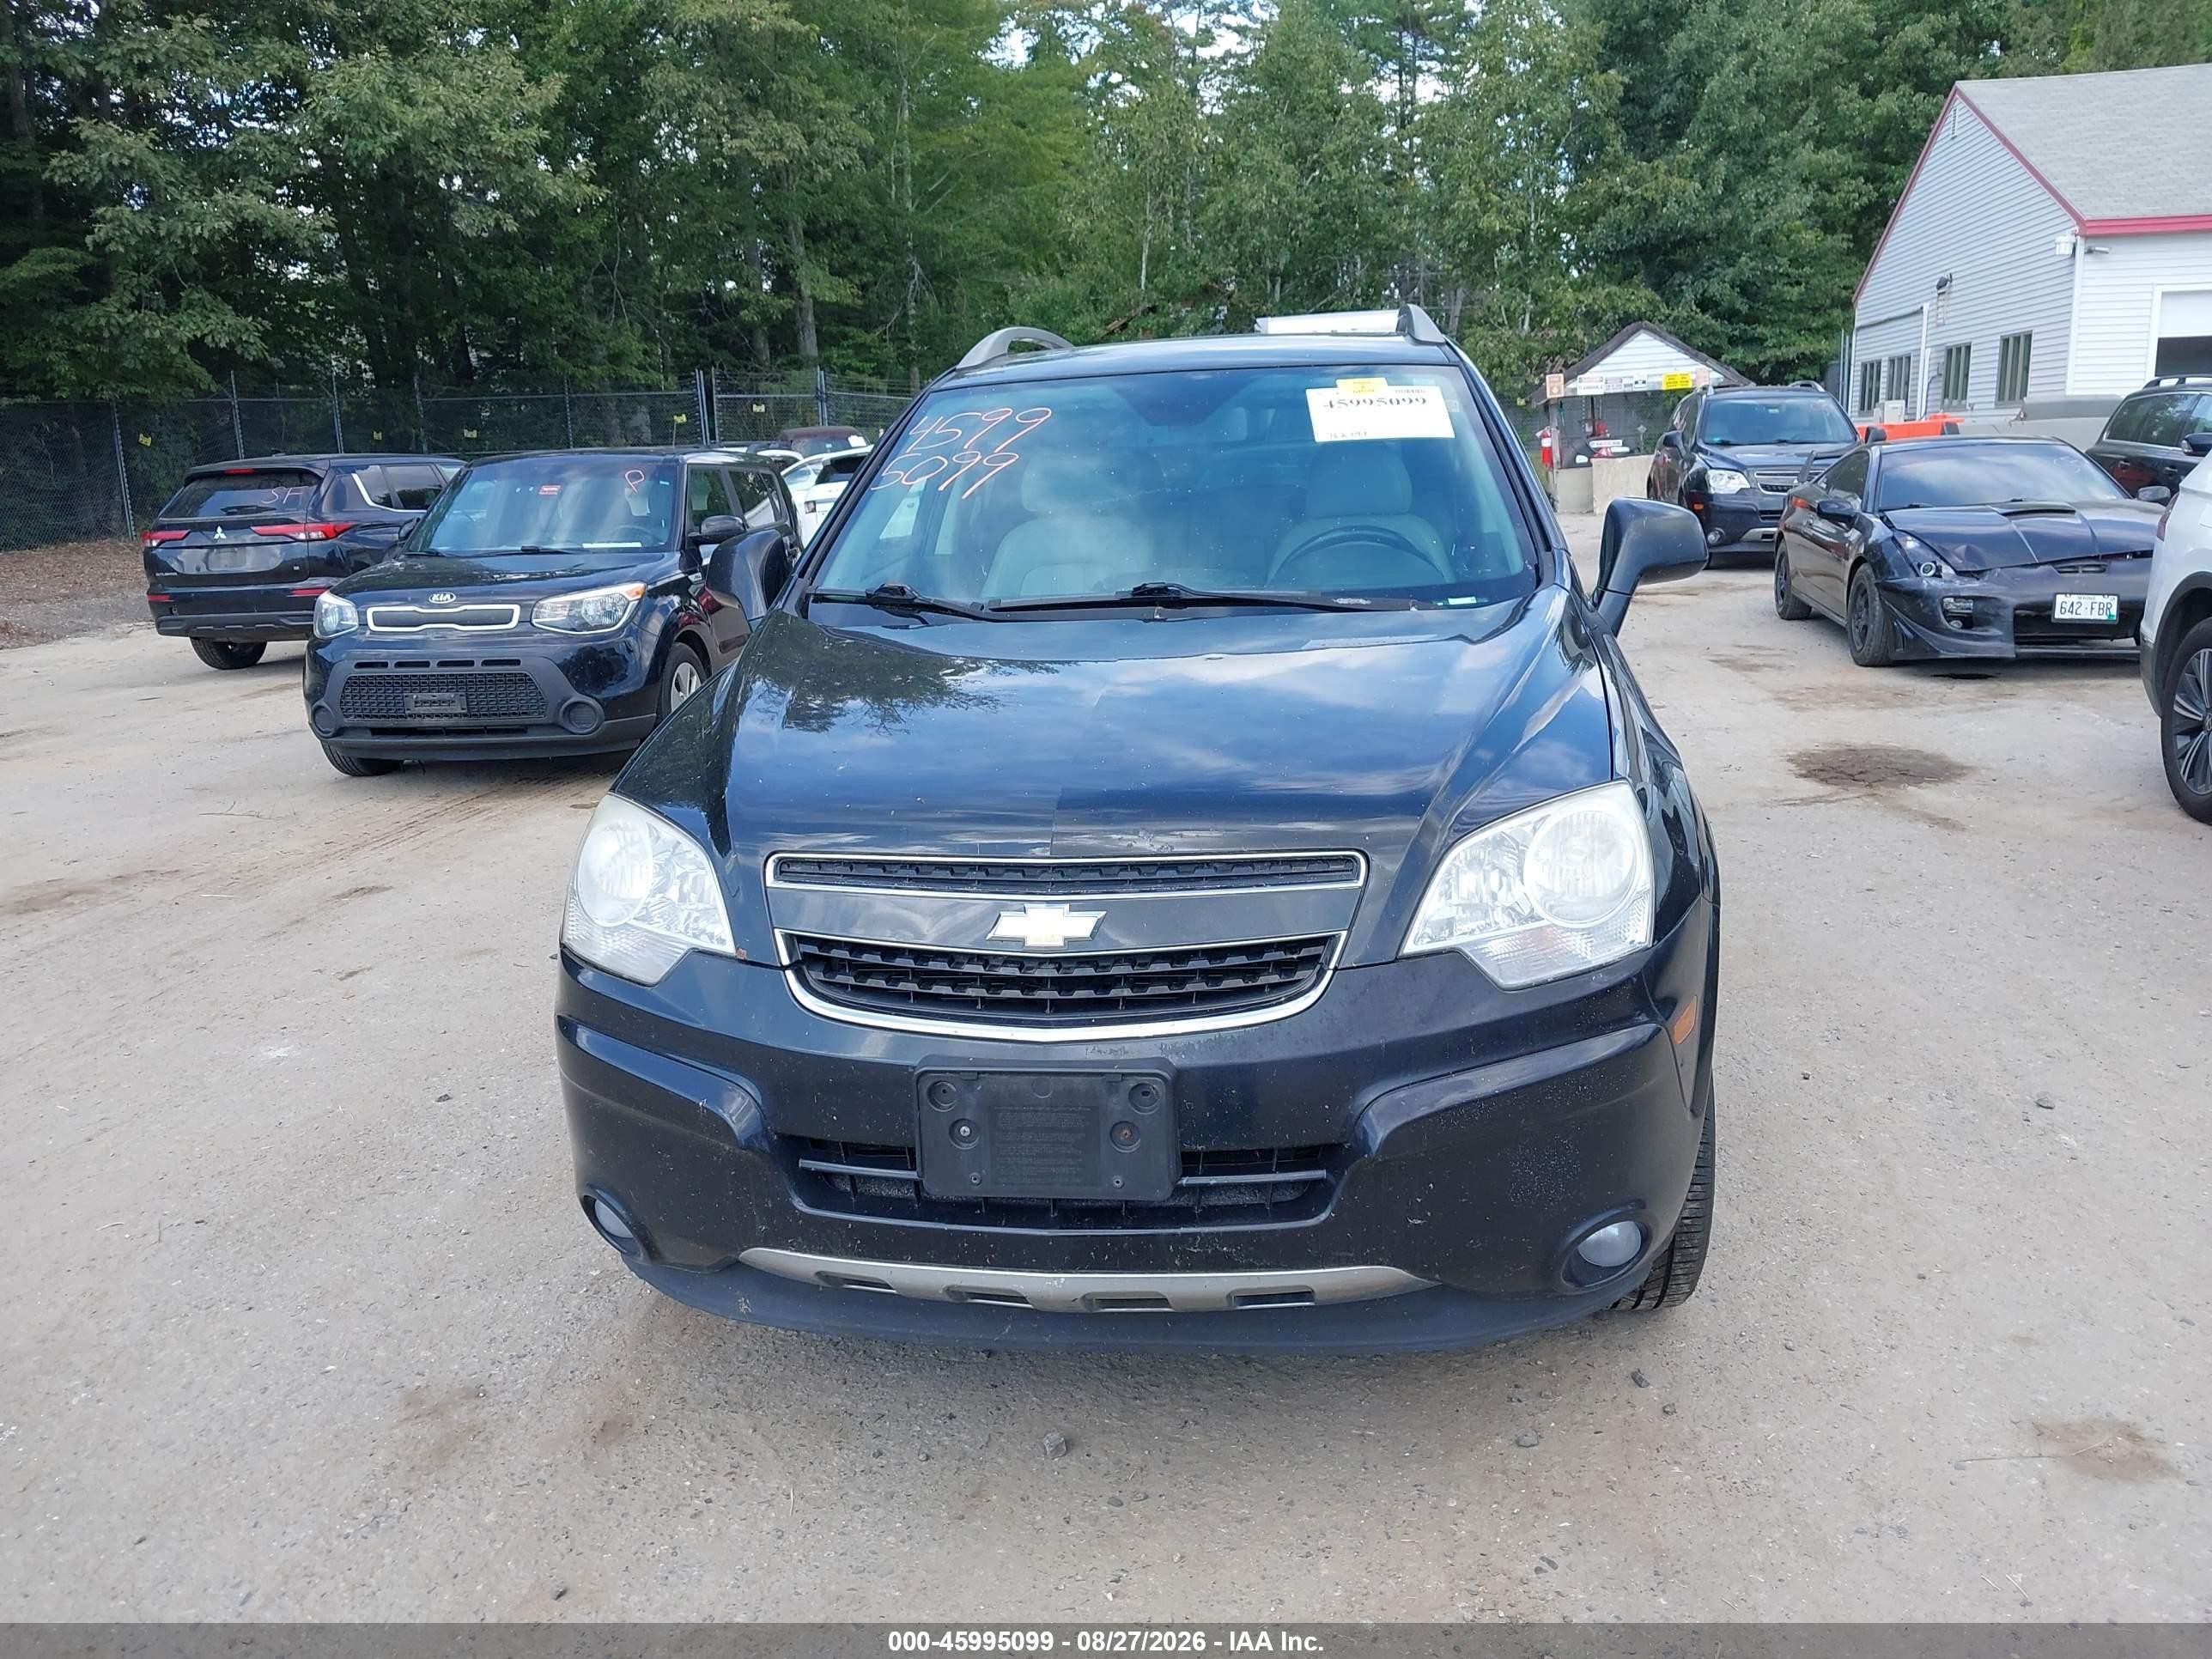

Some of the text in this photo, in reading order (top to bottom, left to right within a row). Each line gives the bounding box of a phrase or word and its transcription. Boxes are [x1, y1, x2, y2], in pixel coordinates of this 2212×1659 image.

[906, 407, 1052, 453] 4599
[624, 469, 645, 493] P
[871, 451, 1020, 500] 5099
[431, 592, 452, 601] KIA
